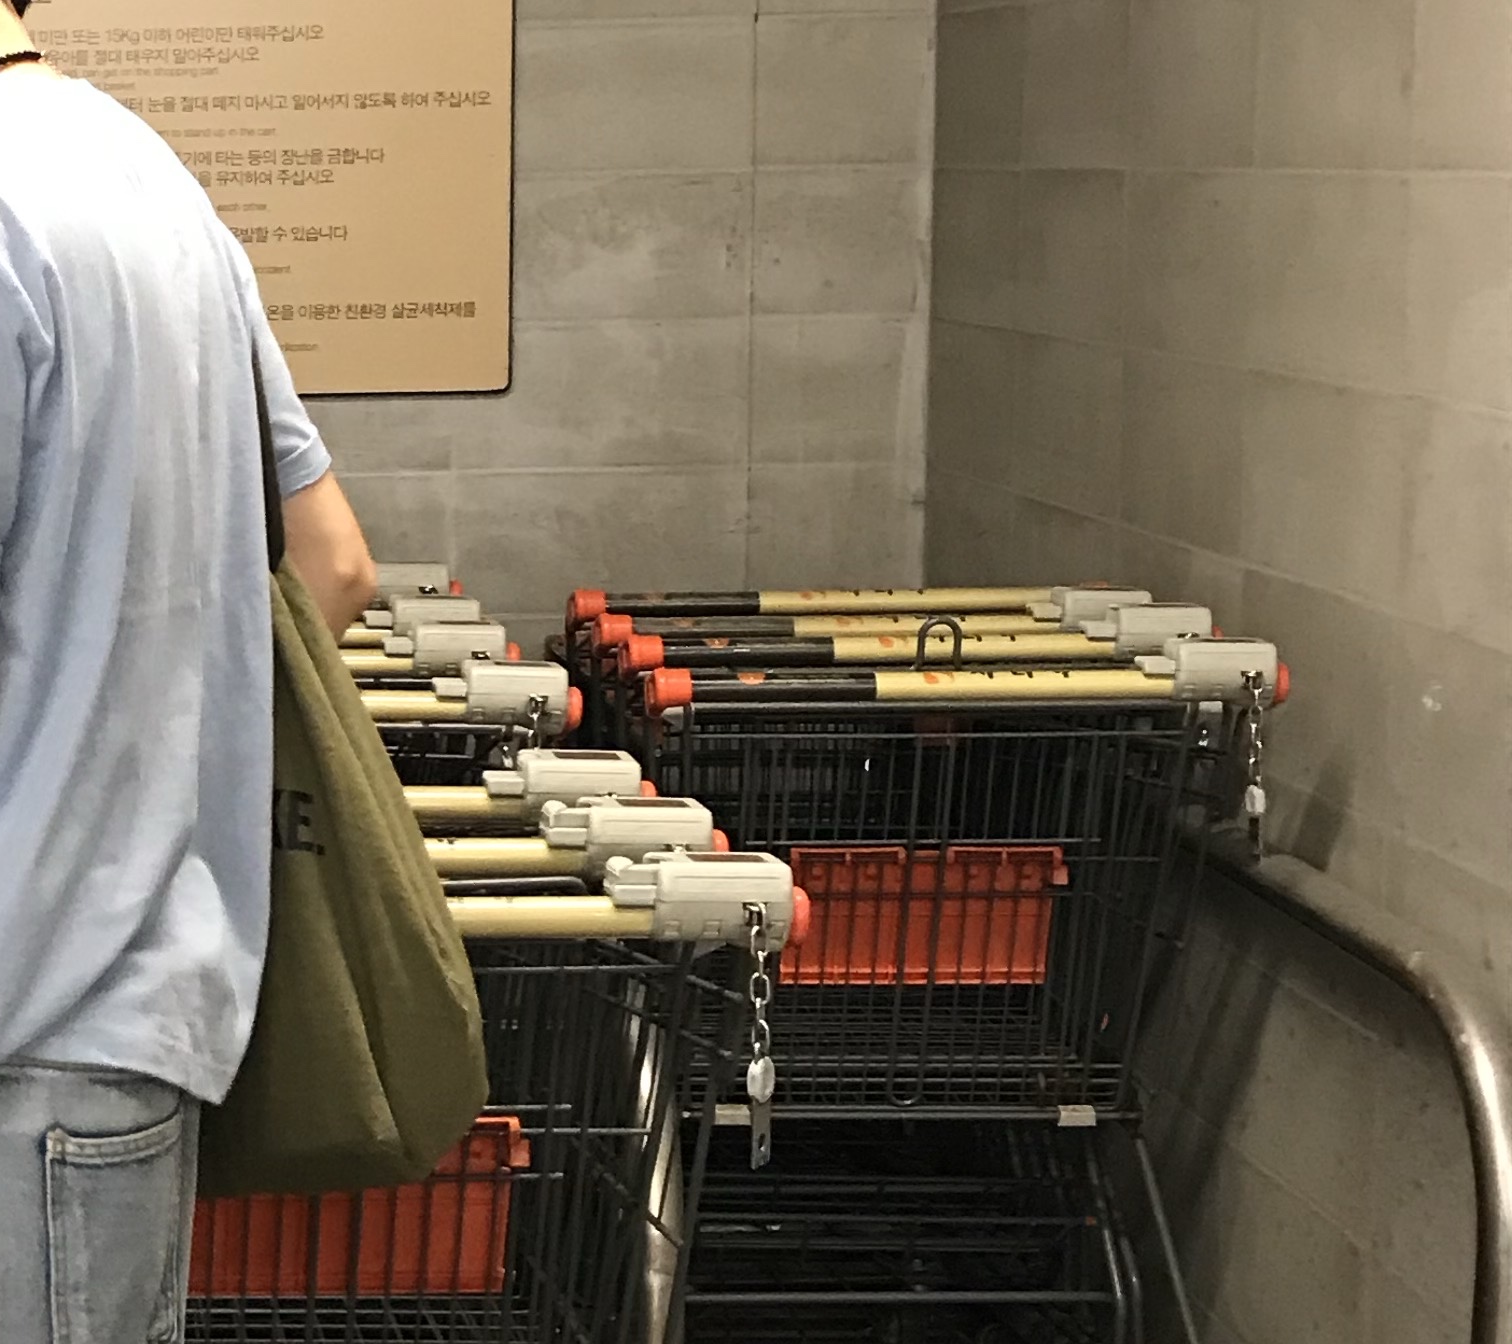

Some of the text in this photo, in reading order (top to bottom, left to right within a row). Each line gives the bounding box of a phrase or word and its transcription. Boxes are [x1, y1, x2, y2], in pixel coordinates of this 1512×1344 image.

[433, 90, 492, 108] 주십시오
[177, 150, 212, 166] 기에
[276, 168, 335, 186] 주십시오
[264, 304, 294, 321] 온을
